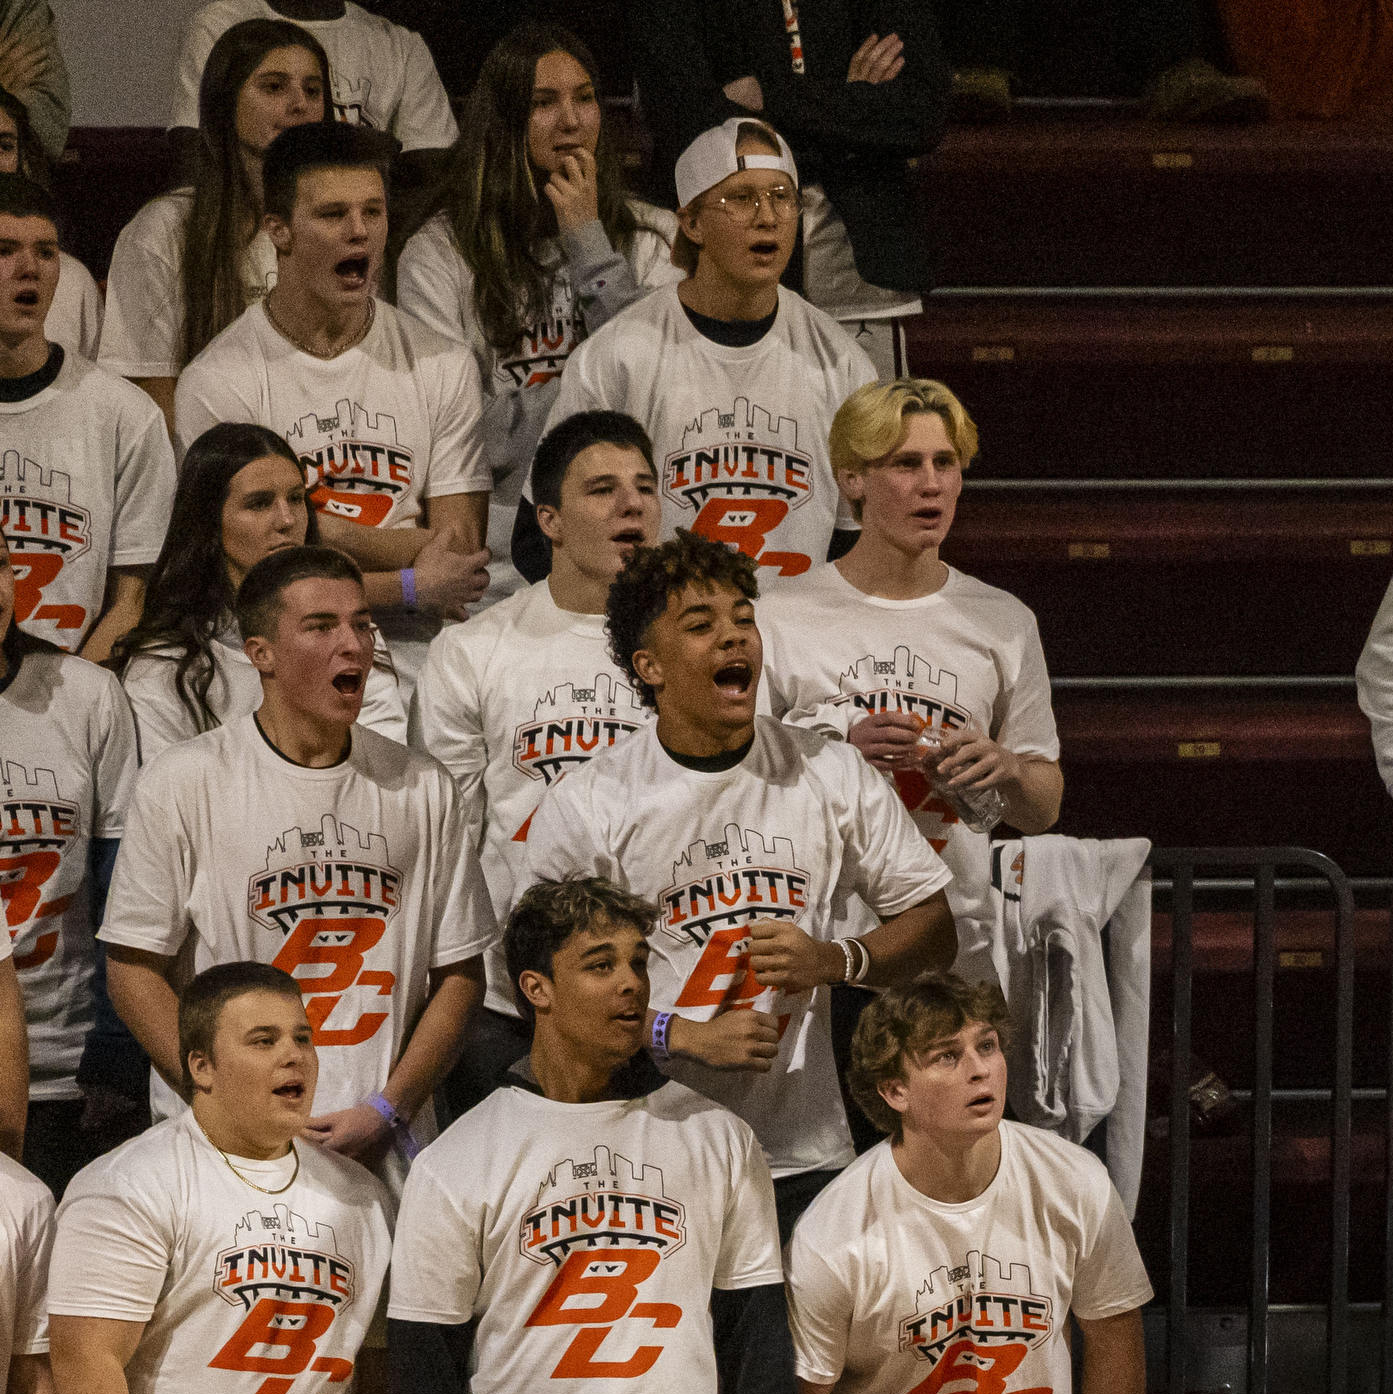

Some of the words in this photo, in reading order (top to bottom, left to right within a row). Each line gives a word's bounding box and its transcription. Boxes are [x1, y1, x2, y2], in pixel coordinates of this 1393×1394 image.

[726, 432, 754, 441] THE
[300, 443, 412, 485] NVITE
[670, 445, 809, 491] INVITE
[885, 678, 914, 689] THE
[581, 706, 616, 716] THE
[311, 850, 347, 858] THE
[717, 856, 752, 869] THE
[255, 864, 399, 910] INVITE
[665, 870, 806, 926] INVITE
[584, 1180, 619, 1190] THE
[272, 1233, 296, 1245] THE
[526, 1195, 680, 1249] INVITE
[222, 1247, 350, 1297] INVITE
[524, 1248, 683, 1379] BC
[906, 1296, 1049, 1345] INVITE
